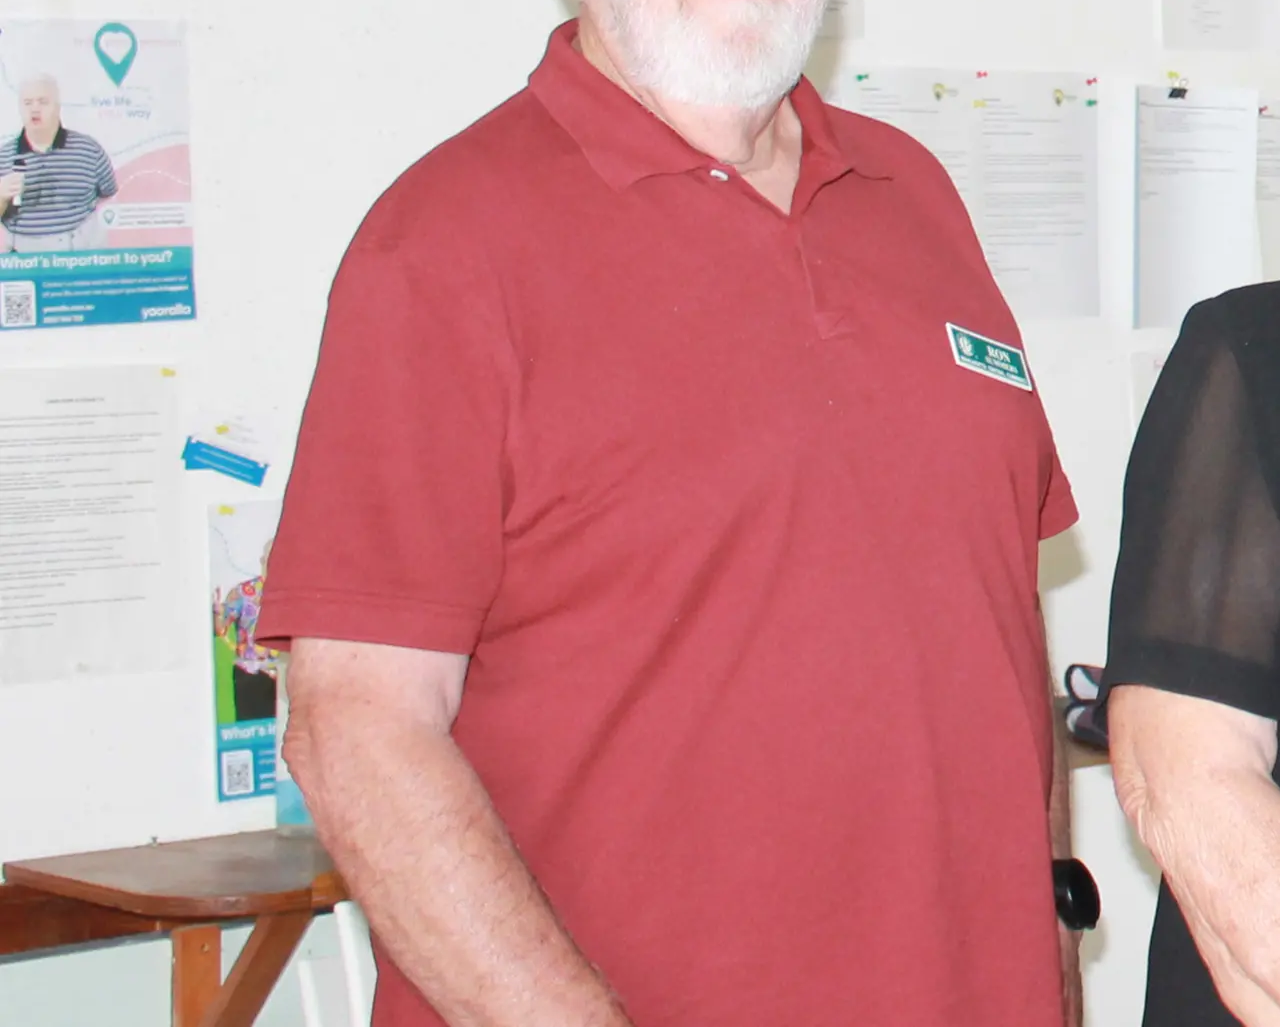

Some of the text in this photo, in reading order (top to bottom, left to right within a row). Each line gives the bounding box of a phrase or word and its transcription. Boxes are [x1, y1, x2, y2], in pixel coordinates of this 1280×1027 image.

[53, 252, 122, 271] important
[125, 252, 139, 264] to
[141, 250, 173, 267] you?
[986, 344, 1012, 364] RON
